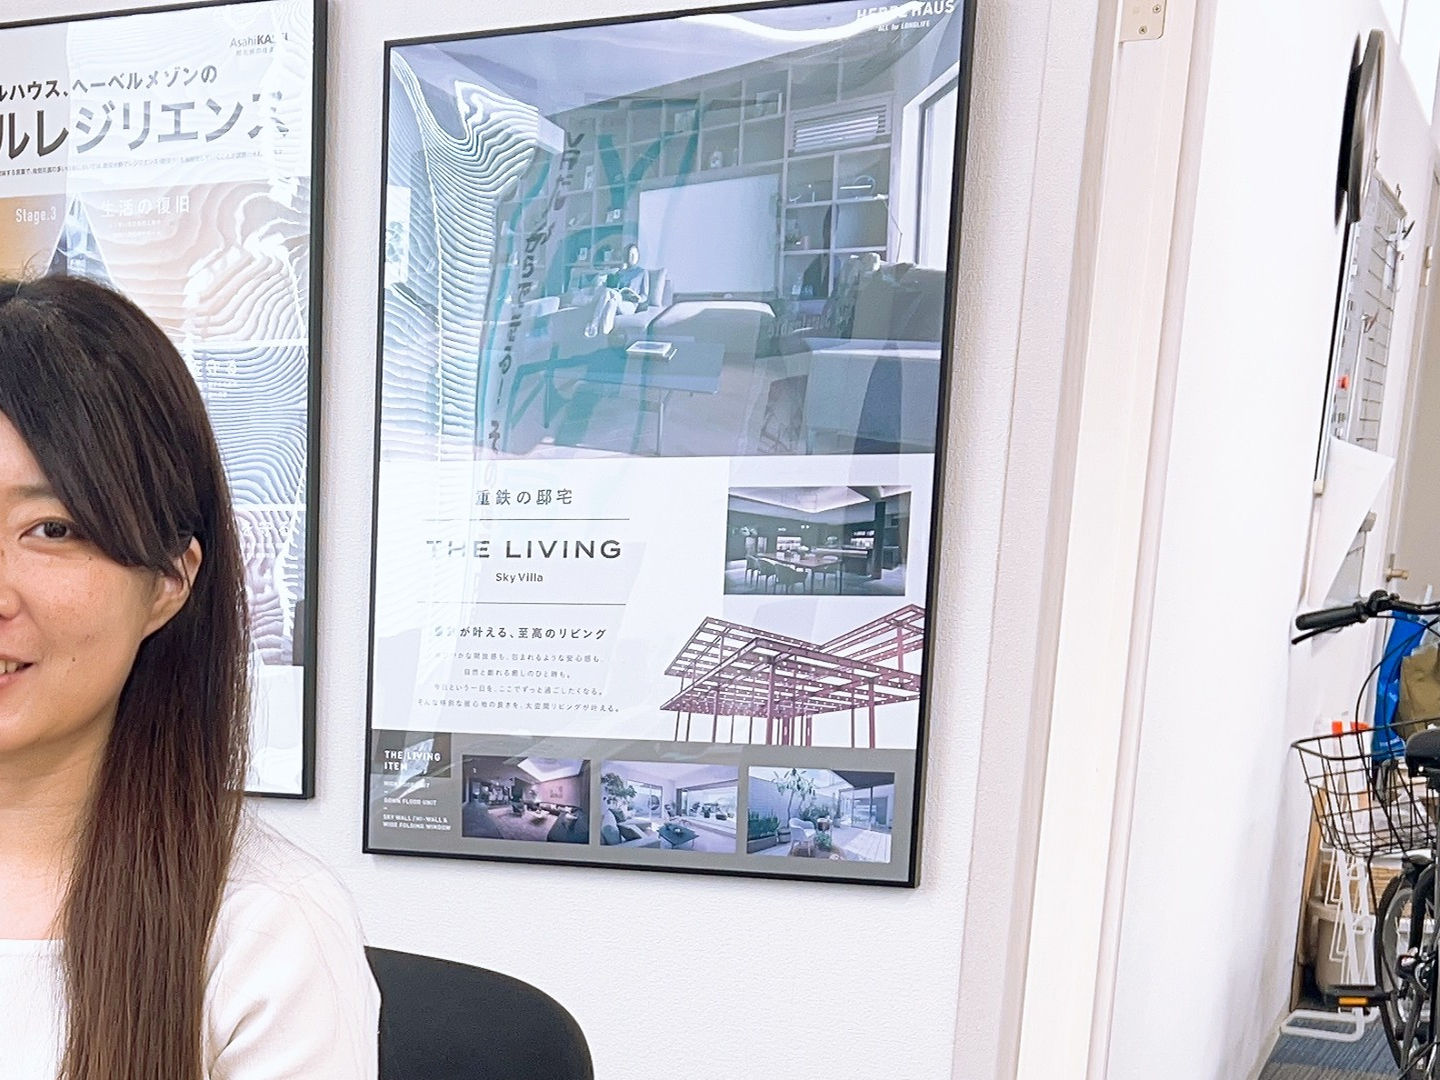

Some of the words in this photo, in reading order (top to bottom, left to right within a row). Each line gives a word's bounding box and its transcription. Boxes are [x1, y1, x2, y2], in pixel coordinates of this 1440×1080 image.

[100, 195, 190, 218] 生活の復旧
[476, 488, 573, 506] 重鉄の邸宅
[426, 540, 490, 558] THE
[505, 540, 622, 559] LIVING
[435, 626, 607, 640] が叶える、至高のリビング
[384, 750, 403, 760] THE
[407, 752, 441, 762] LIVING
[384, 761, 408, 771] ITEM
